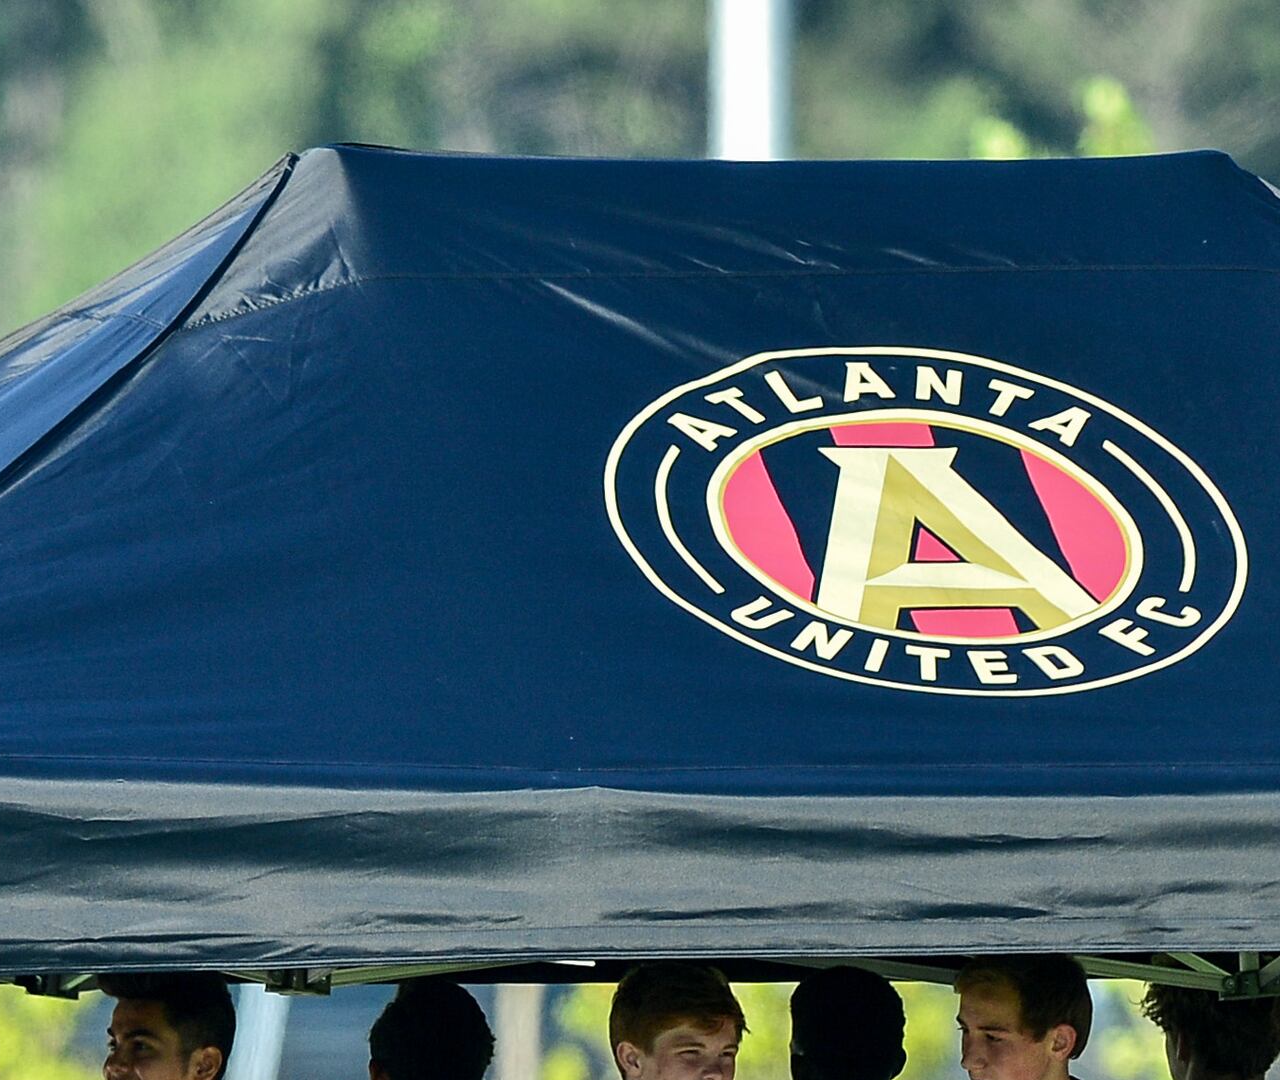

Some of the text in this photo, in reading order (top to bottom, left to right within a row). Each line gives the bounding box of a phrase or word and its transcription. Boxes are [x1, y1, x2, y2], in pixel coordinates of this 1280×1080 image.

[667, 361, 1091, 452] ATLANTA
[730, 595, 1202, 685] UNITED FC
